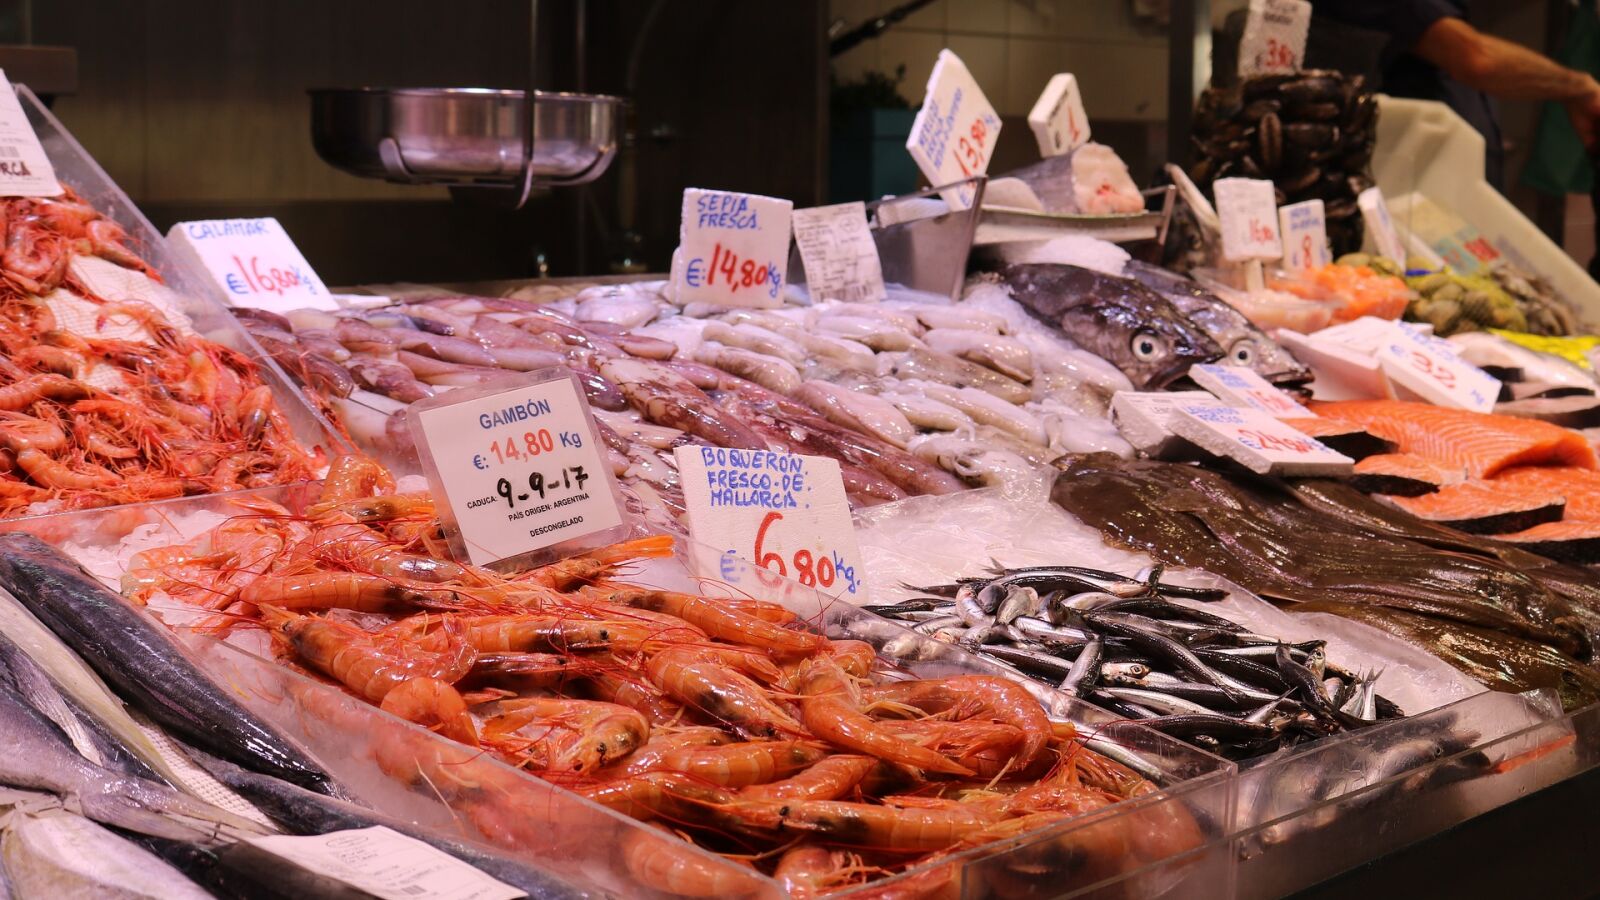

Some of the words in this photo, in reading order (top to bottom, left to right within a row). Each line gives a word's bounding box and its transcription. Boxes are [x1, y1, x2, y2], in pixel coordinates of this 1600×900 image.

[188, 220, 270, 240] CALAMAR
[232, 254, 300, 296] 16,80
[707, 242, 768, 293] 14,80
[226, 272, 249, 295] €
[480, 399, 551, 429] GAMBÓN
[490, 428, 554, 465] 14,80
[559, 431, 582, 448] Kg
[467, 495, 497, 509] CADUCA:
[508, 510, 524, 522] PAÍS
[525, 504, 553, 518] ORIGEN:
[553, 492, 590, 509] ARGENTINA
[529, 515, 584, 538] DESCONGELADO
